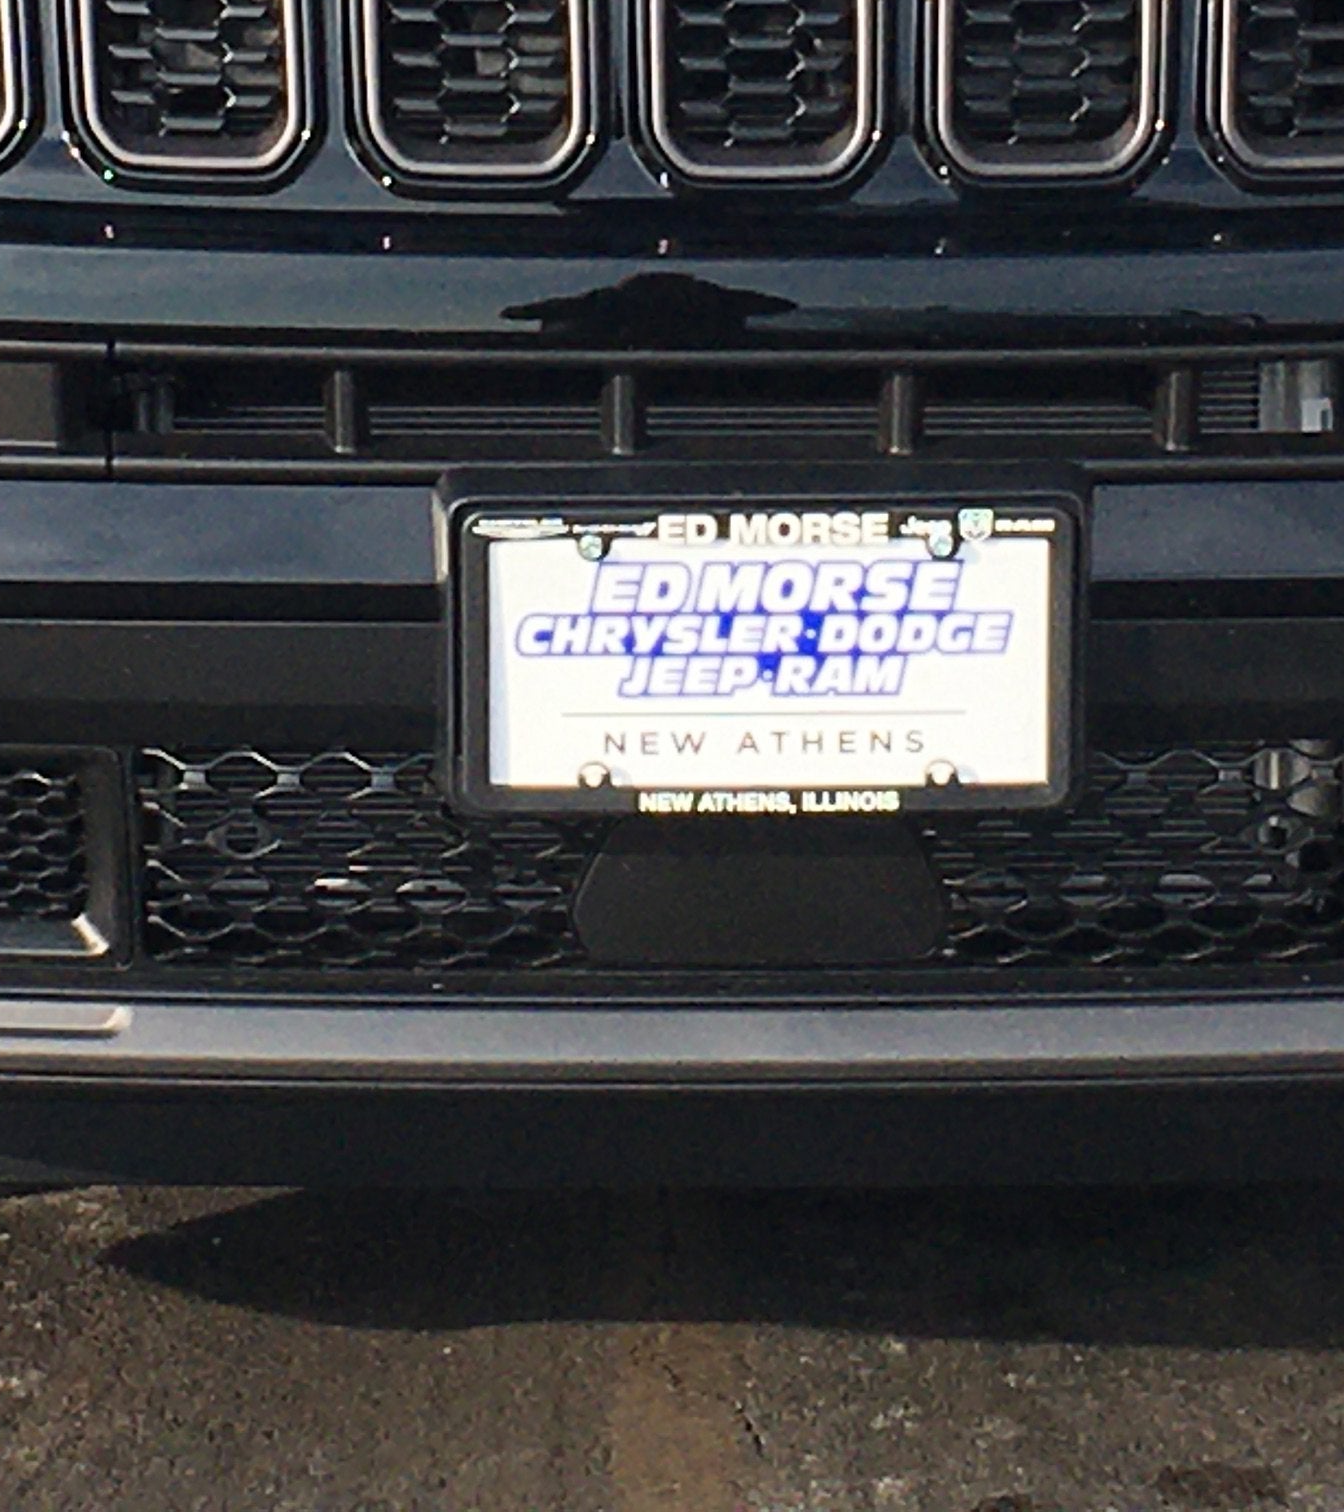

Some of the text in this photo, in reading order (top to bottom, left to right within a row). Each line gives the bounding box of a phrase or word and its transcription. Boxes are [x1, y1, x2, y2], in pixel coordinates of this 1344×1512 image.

[658, 512, 718, 545] ED
[730, 511, 889, 545] MORSE
[590, 560, 964, 614] ED MORSE
[603, 729, 925, 755] NEW ATHENS
[639, 790, 900, 815] NEW ATHENS, ILLINOIS
